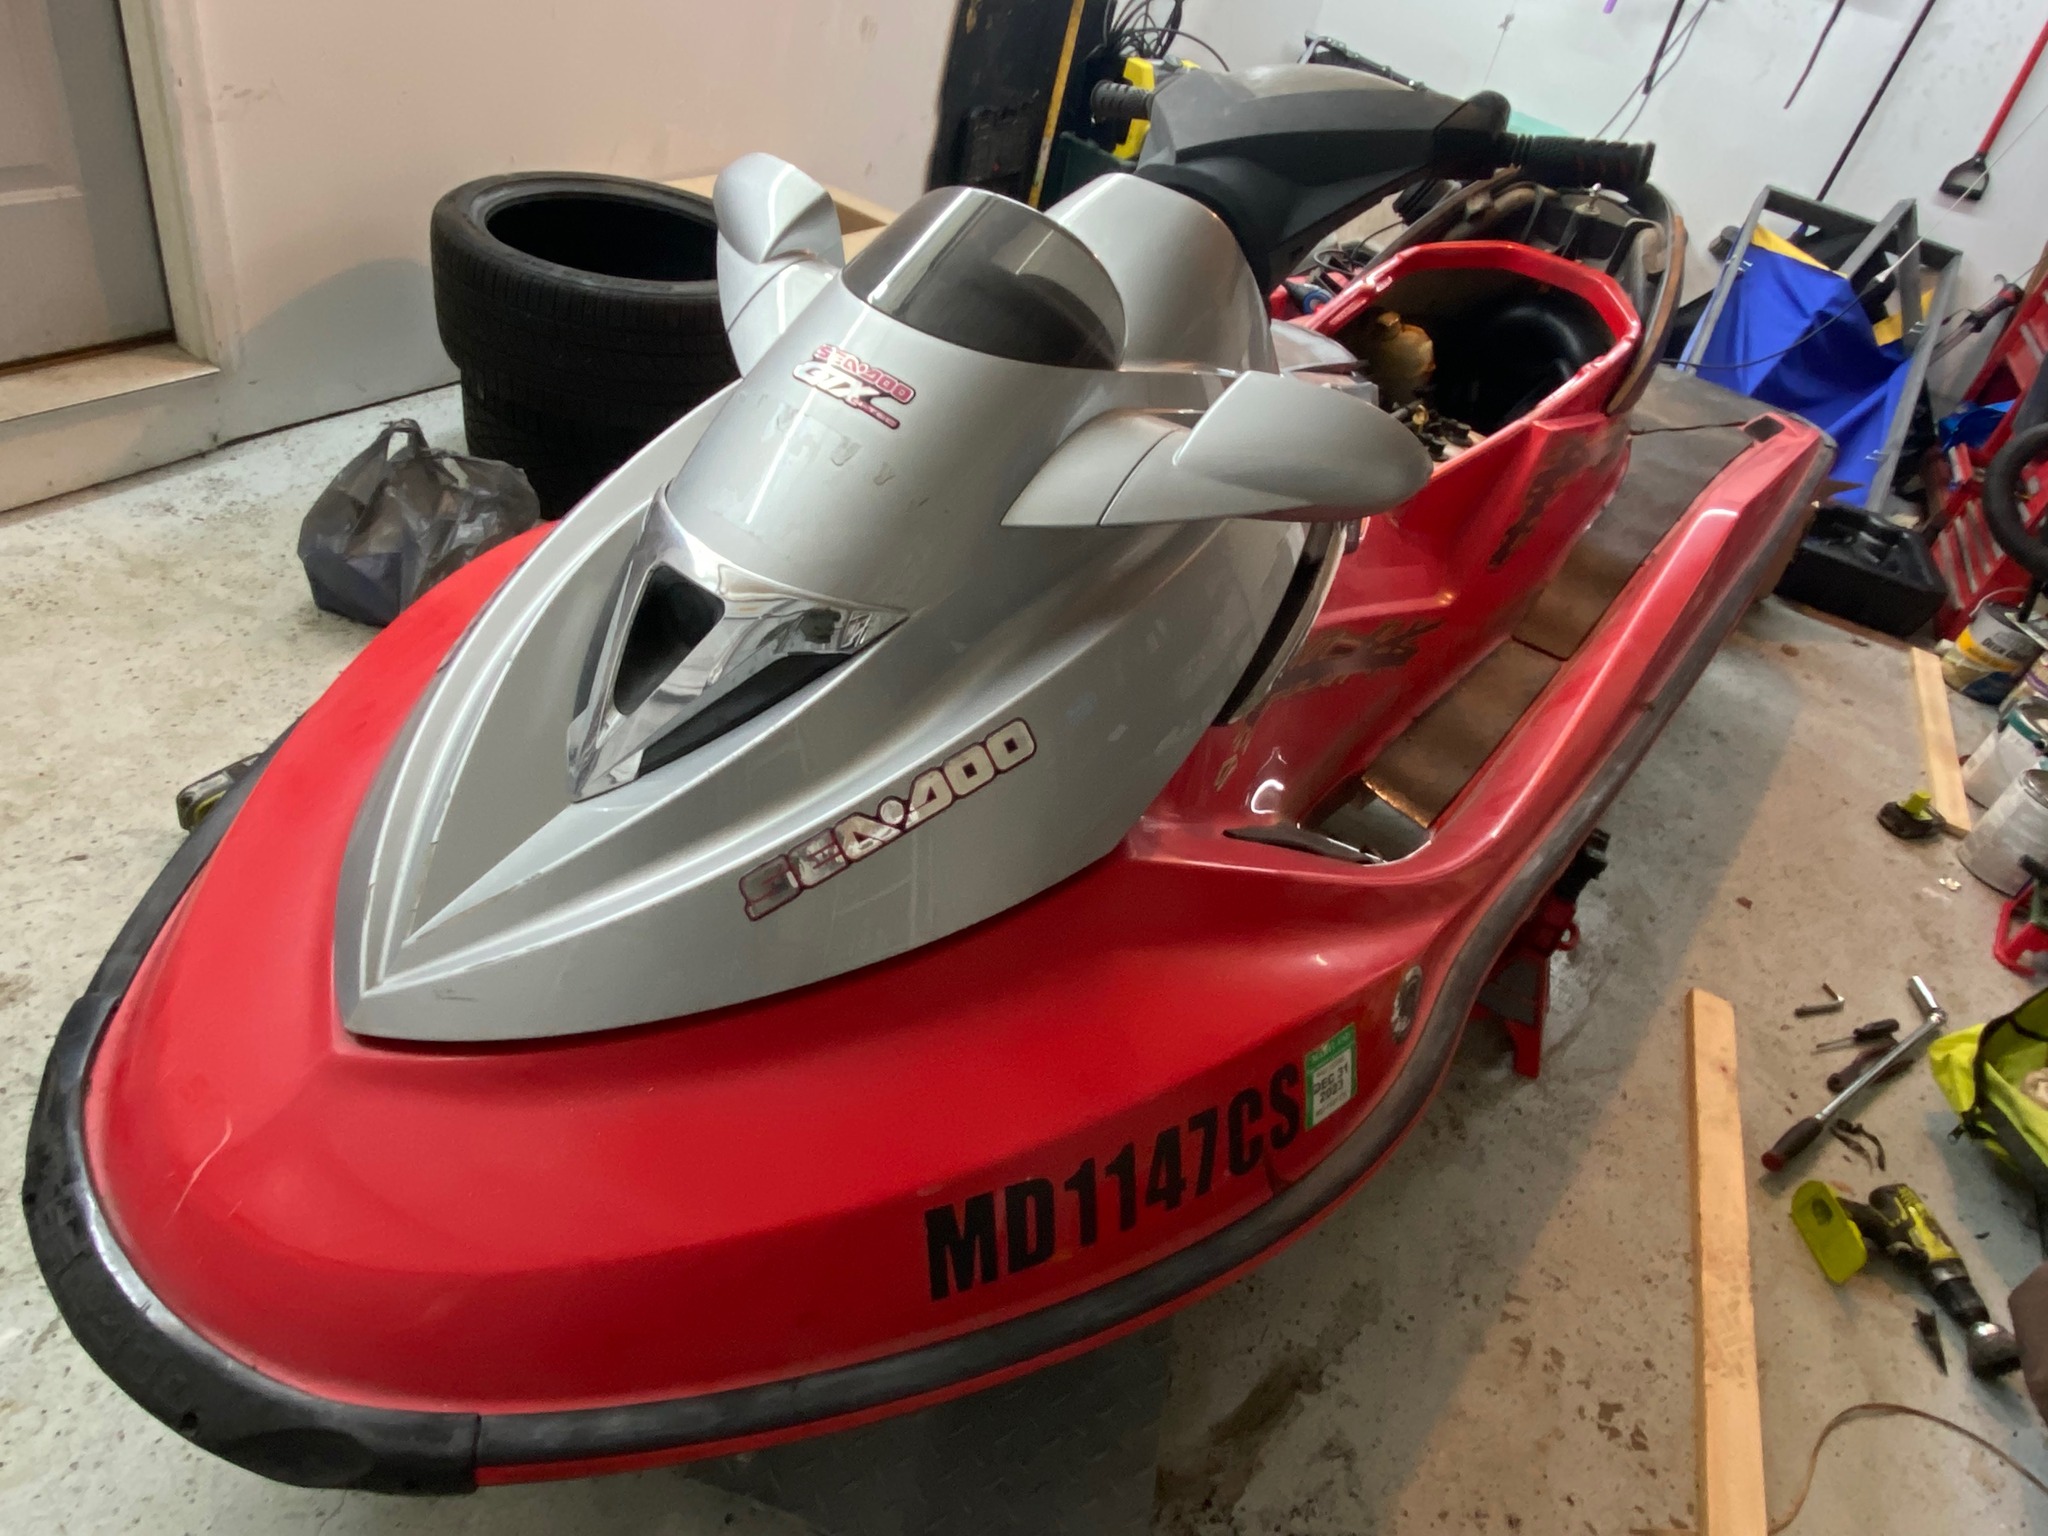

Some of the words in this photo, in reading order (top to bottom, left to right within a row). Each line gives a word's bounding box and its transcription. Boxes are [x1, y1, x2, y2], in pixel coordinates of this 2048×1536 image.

[793, 361, 881, 408] GTX
[1312, 1072, 1336, 1096] DEC
[924, 1063, 1300, 1301] MD1147CS
